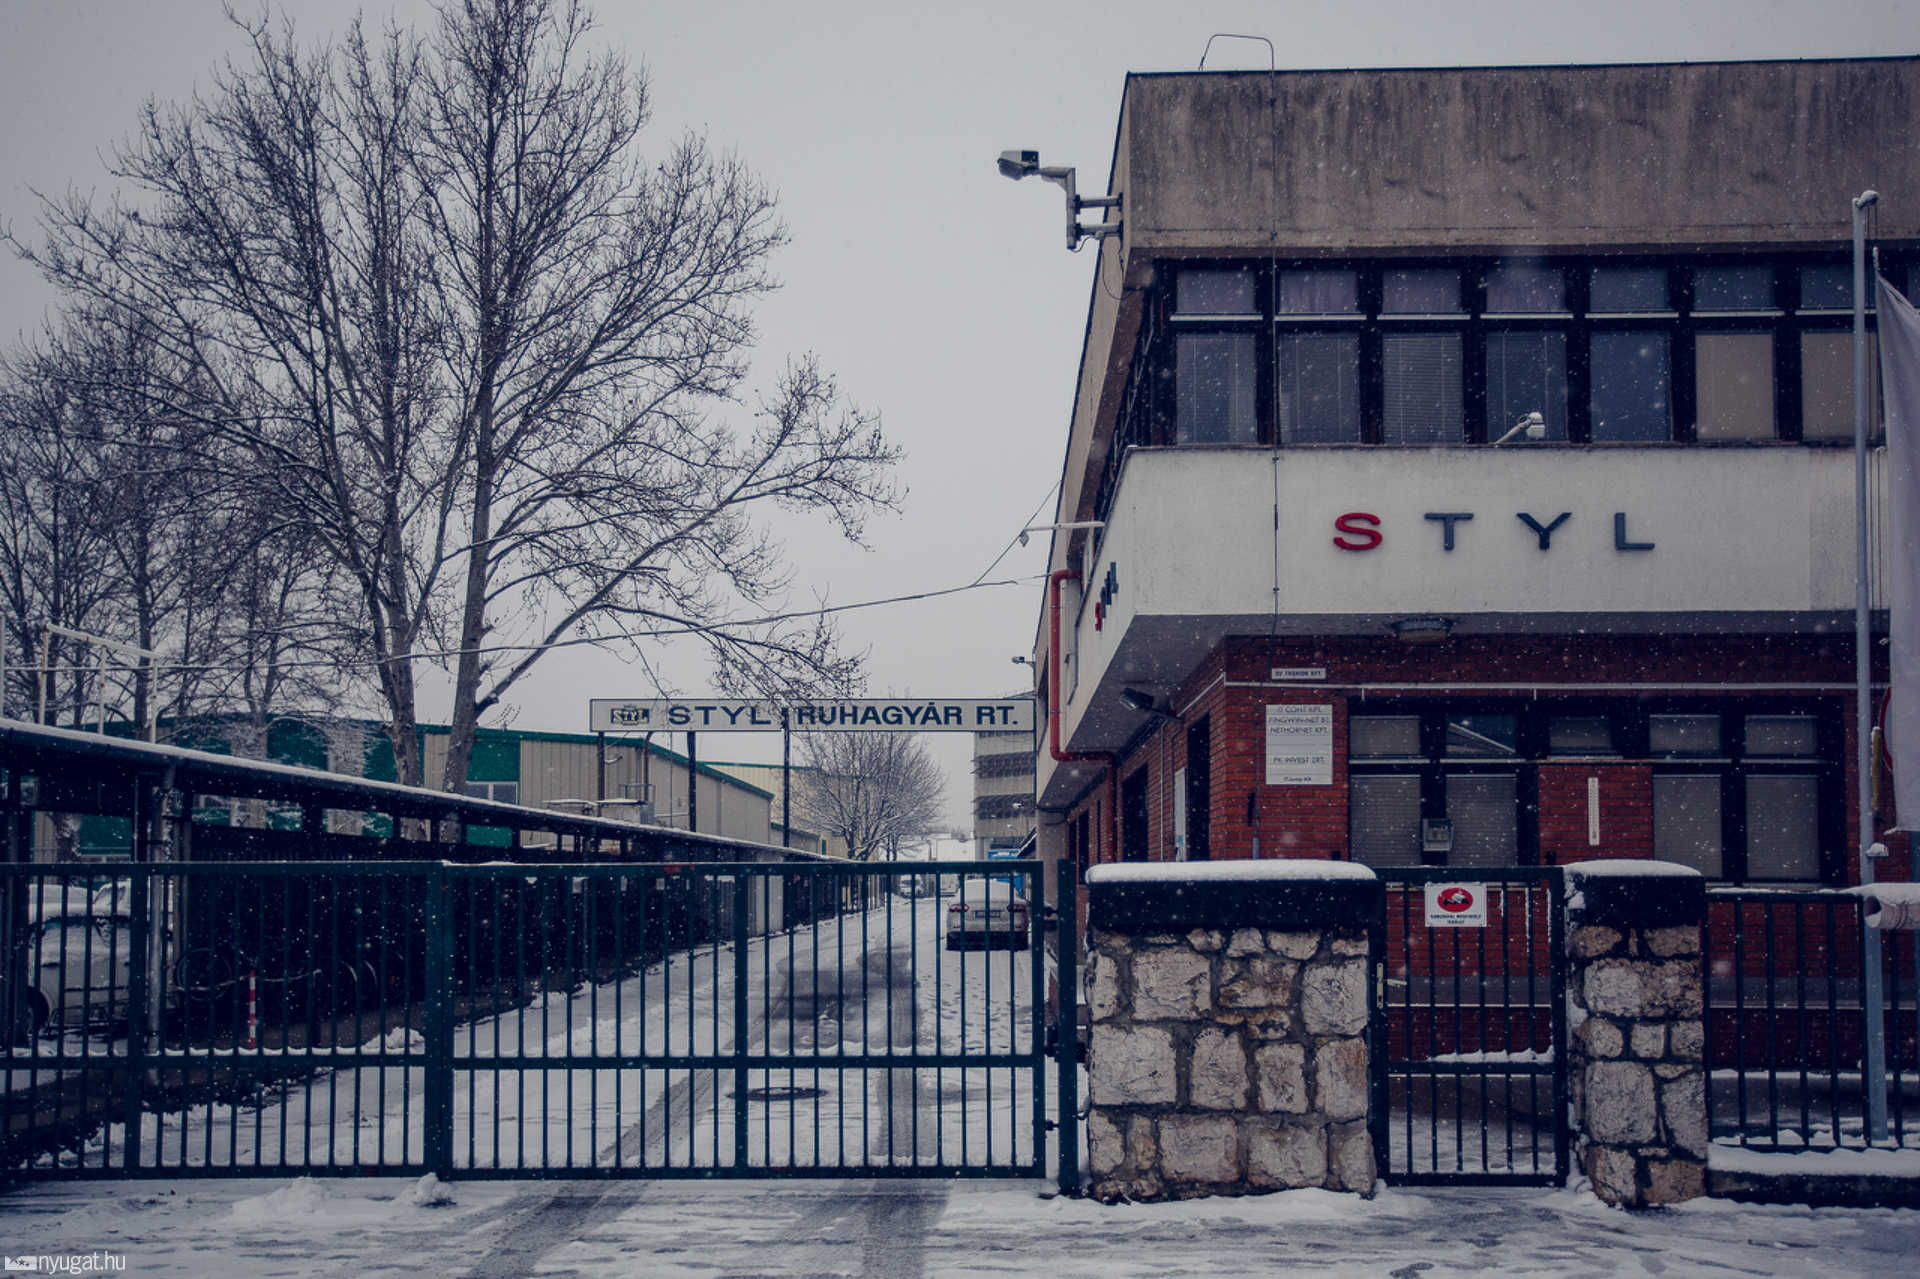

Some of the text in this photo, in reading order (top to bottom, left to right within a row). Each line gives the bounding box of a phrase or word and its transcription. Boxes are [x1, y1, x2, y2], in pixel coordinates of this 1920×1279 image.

[1333, 512, 1656, 551] STYL
[612, 709, 649, 724] STYL
[668, 702, 1019, 726] STYL RUHAGYÁR RT.
